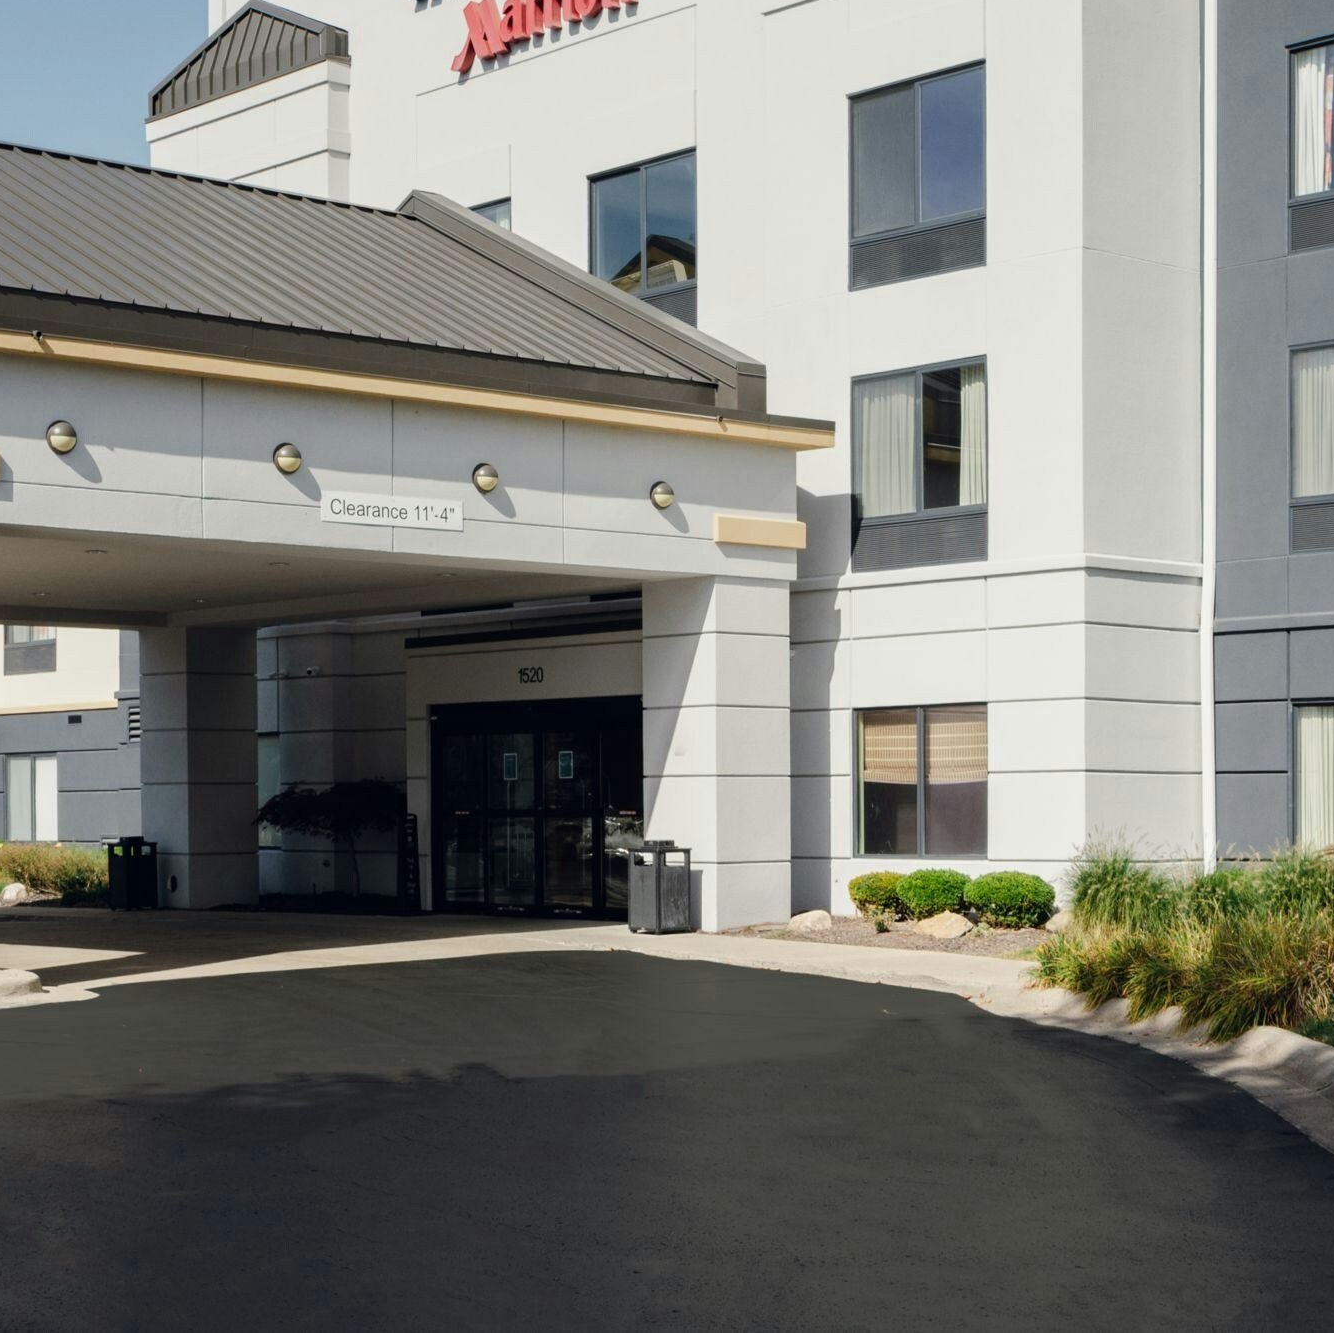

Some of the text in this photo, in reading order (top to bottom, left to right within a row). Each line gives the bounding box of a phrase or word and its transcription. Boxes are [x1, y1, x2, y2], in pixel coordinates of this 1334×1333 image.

[330, 498, 455, 522] Clearance 11'-4"
[518, 667, 544, 684] 1520
